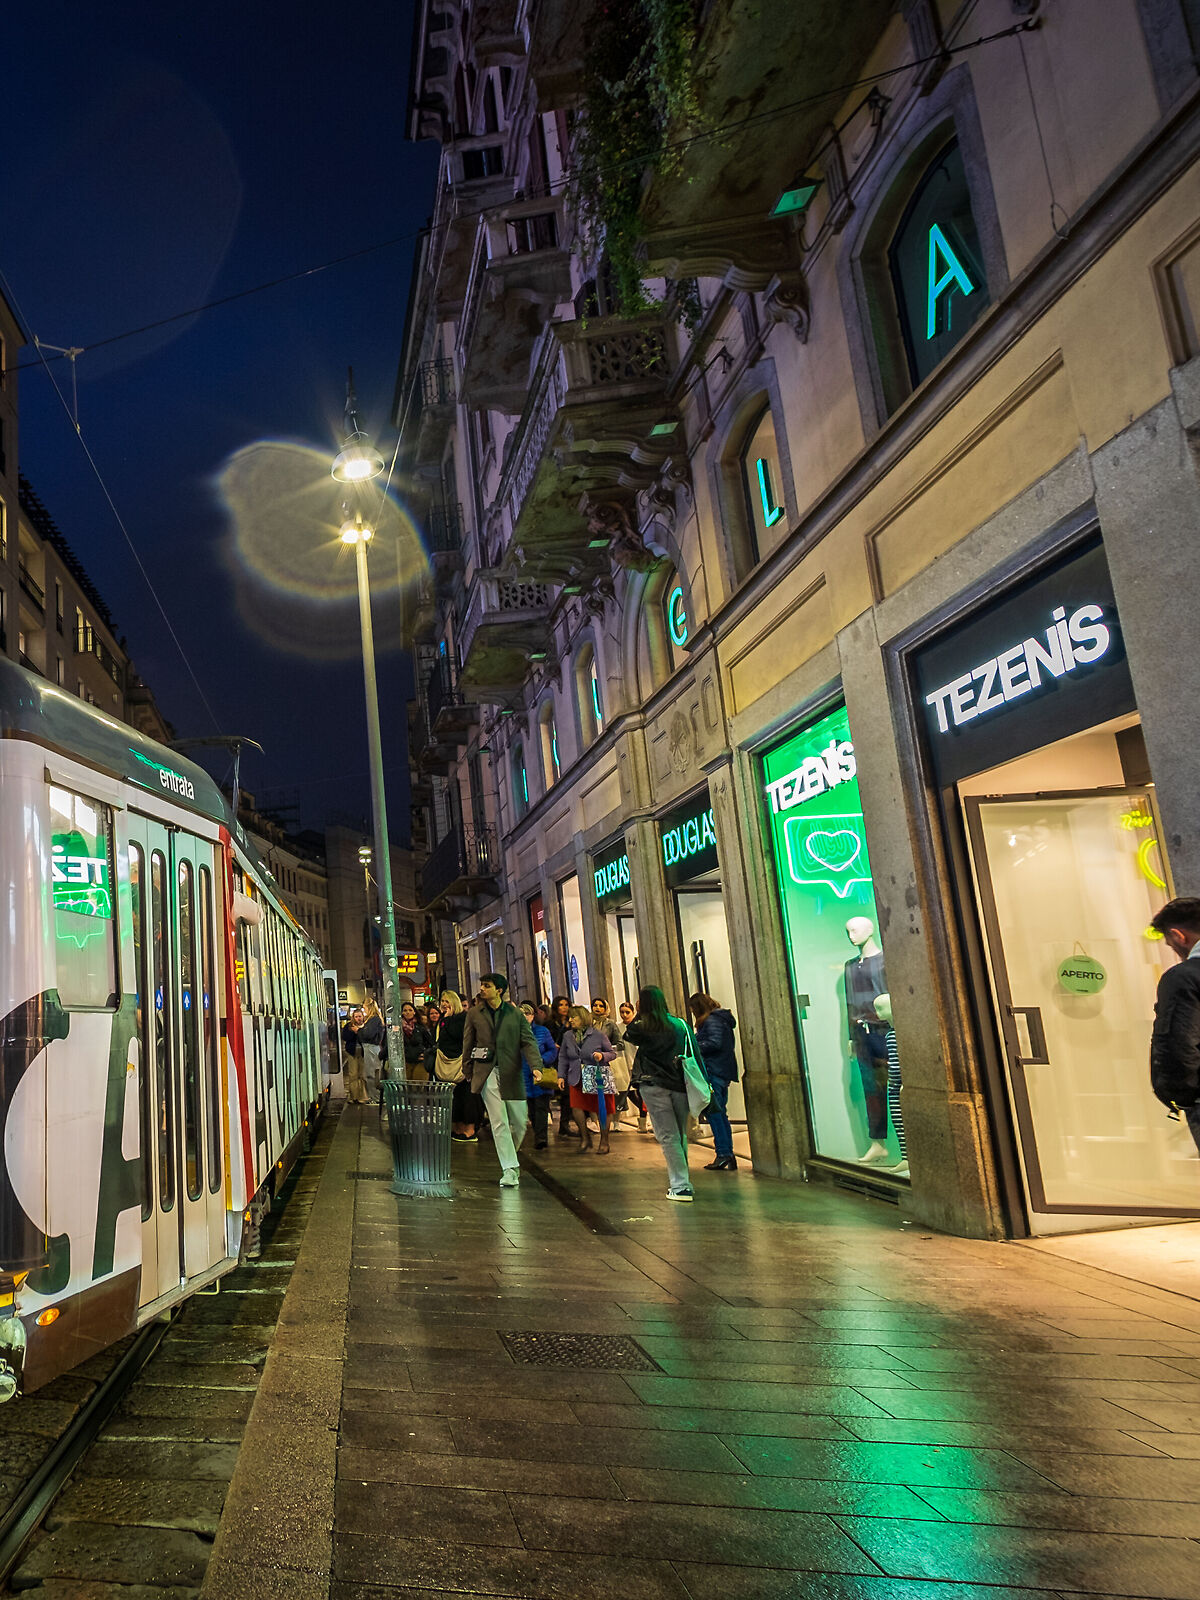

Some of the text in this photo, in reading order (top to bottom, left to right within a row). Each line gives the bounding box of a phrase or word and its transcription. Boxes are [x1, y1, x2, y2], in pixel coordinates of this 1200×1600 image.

[160, 769, 195, 800] entrata
[594, 854, 631, 898] DOUGLAS
[1061, 969, 1104, 981] APERTO
